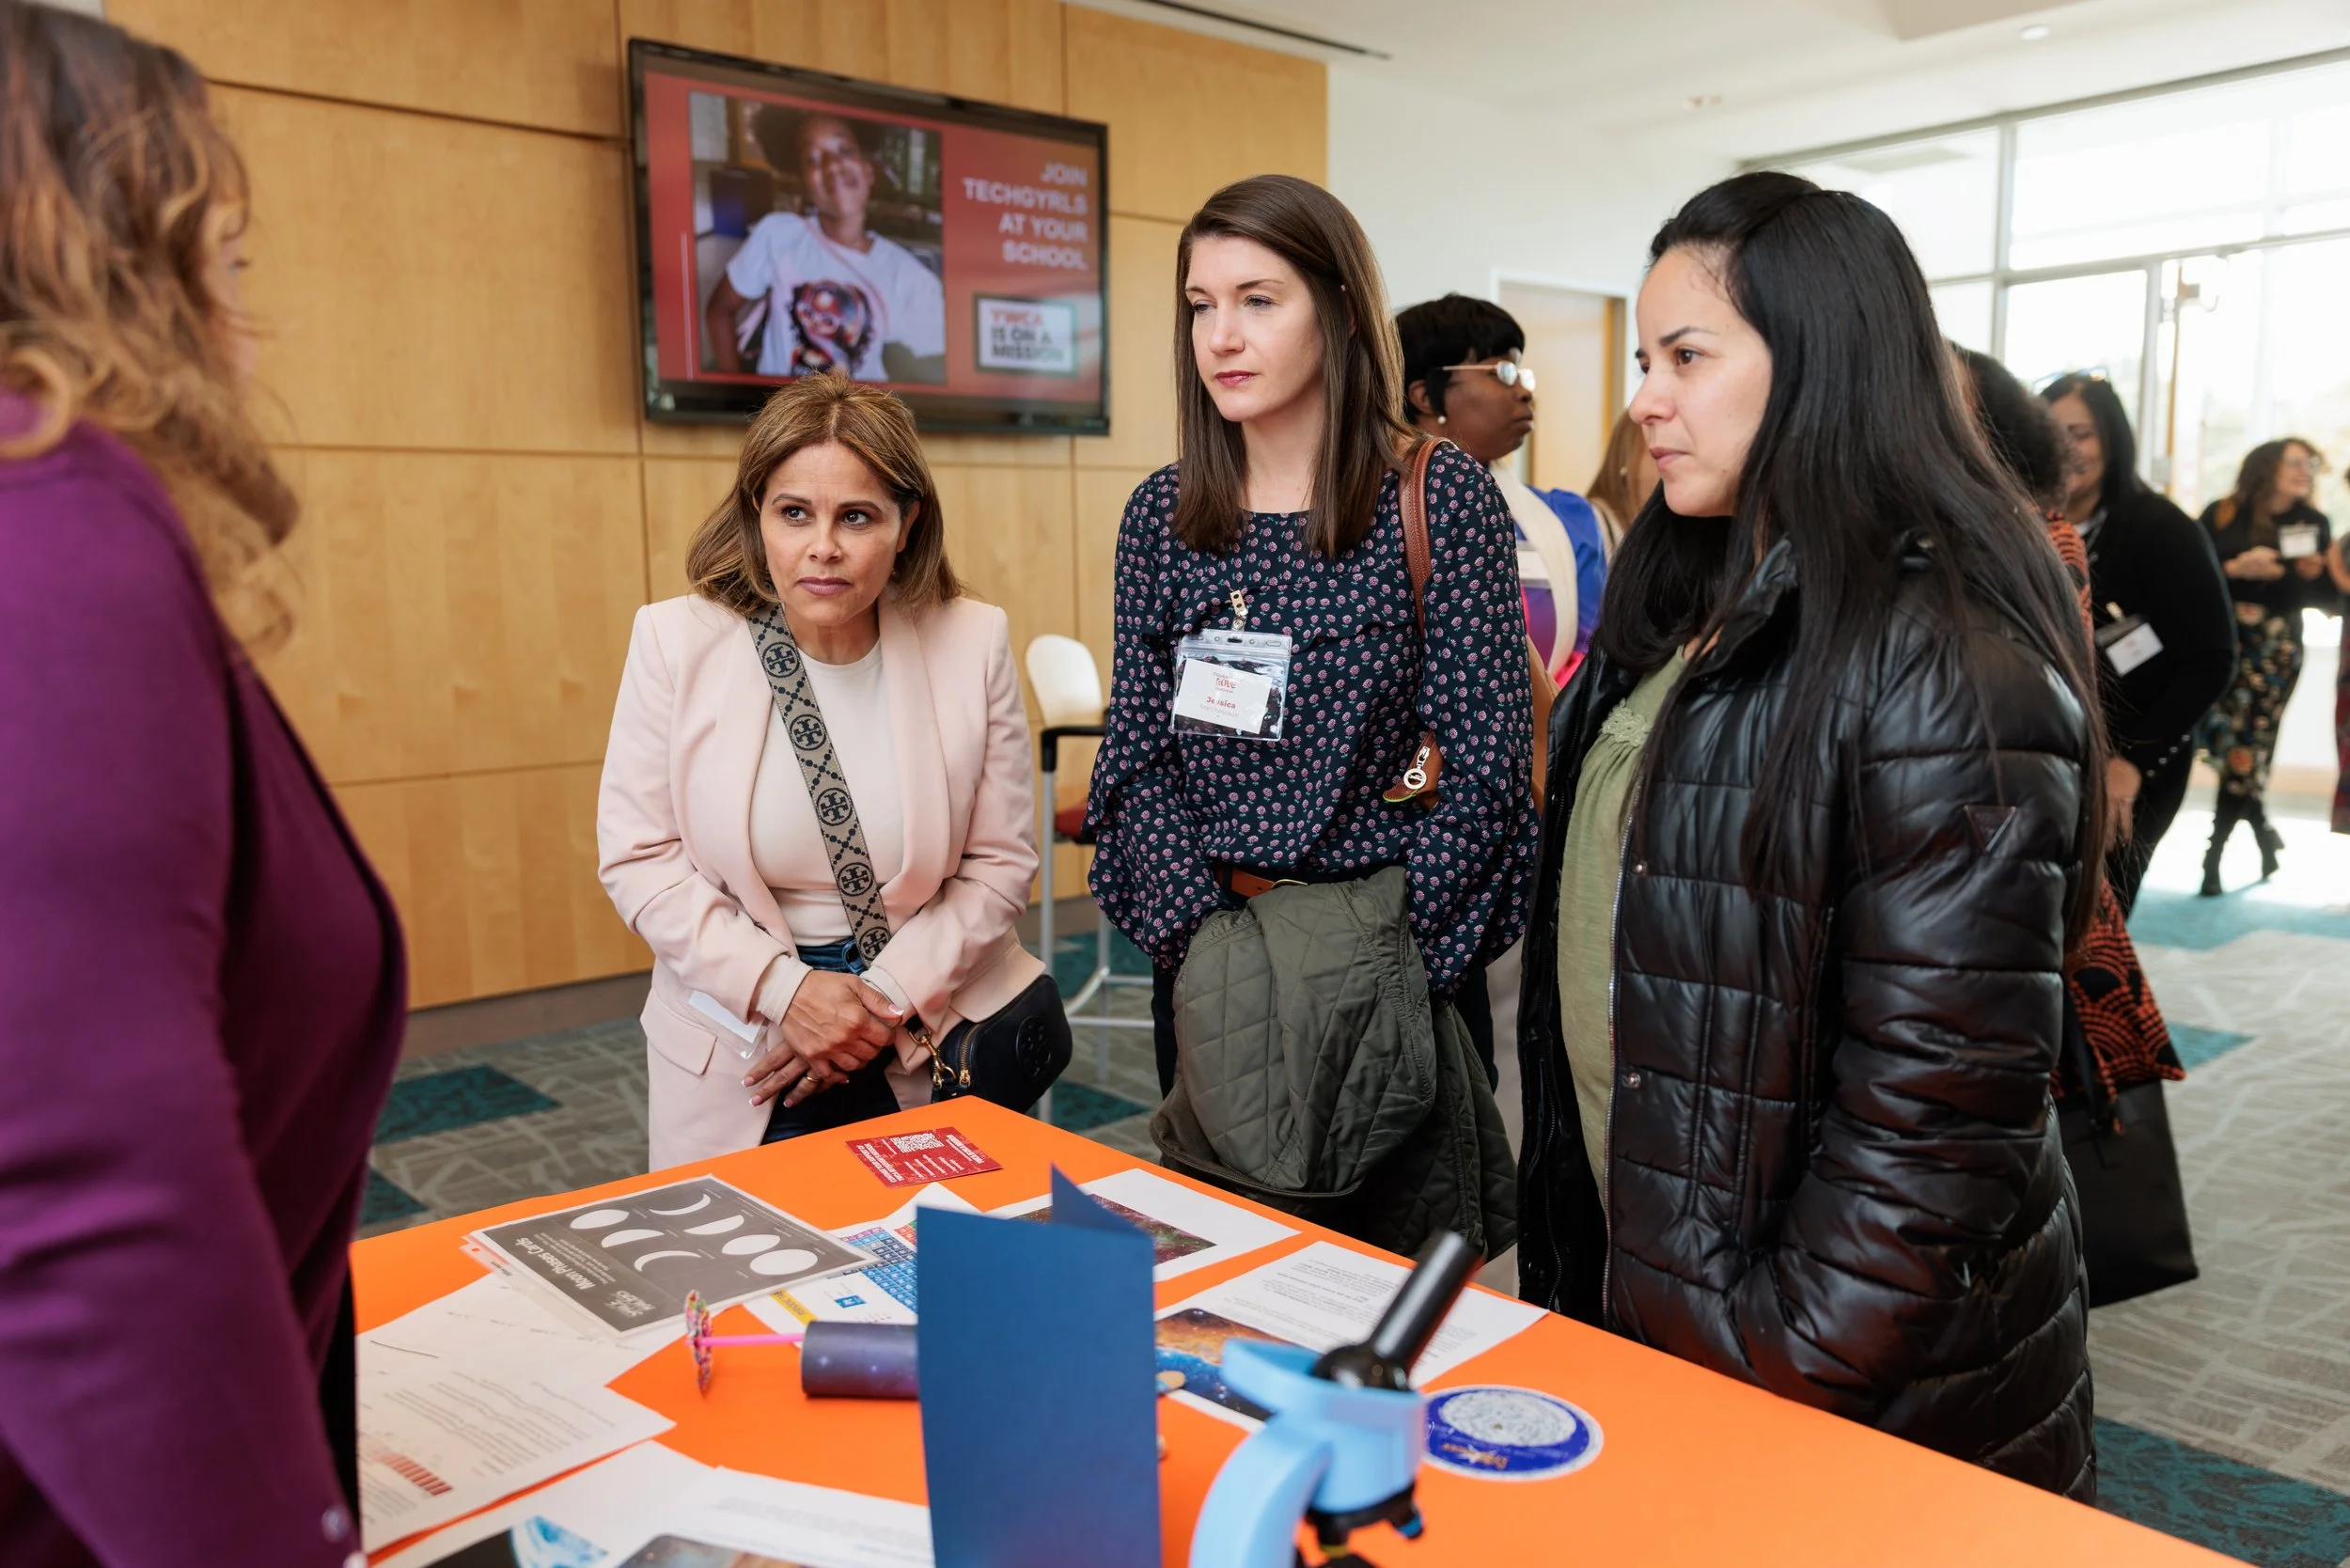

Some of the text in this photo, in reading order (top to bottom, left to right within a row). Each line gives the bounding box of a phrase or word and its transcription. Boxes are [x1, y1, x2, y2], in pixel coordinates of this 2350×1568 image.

[1040, 163, 1088, 187] JOIN
[963, 177, 1088, 216] TECHGYRLS
[998, 212, 1089, 243] AT YOUR
[1002, 240, 1089, 271] SCHOOL
[990, 309, 1044, 327] YWCA
[991, 326, 1006, 343] IS
[991, 344, 1064, 363] MISSION
[538, 1252, 572, 1275] Phases
[566, 1271, 596, 1290] Moon
